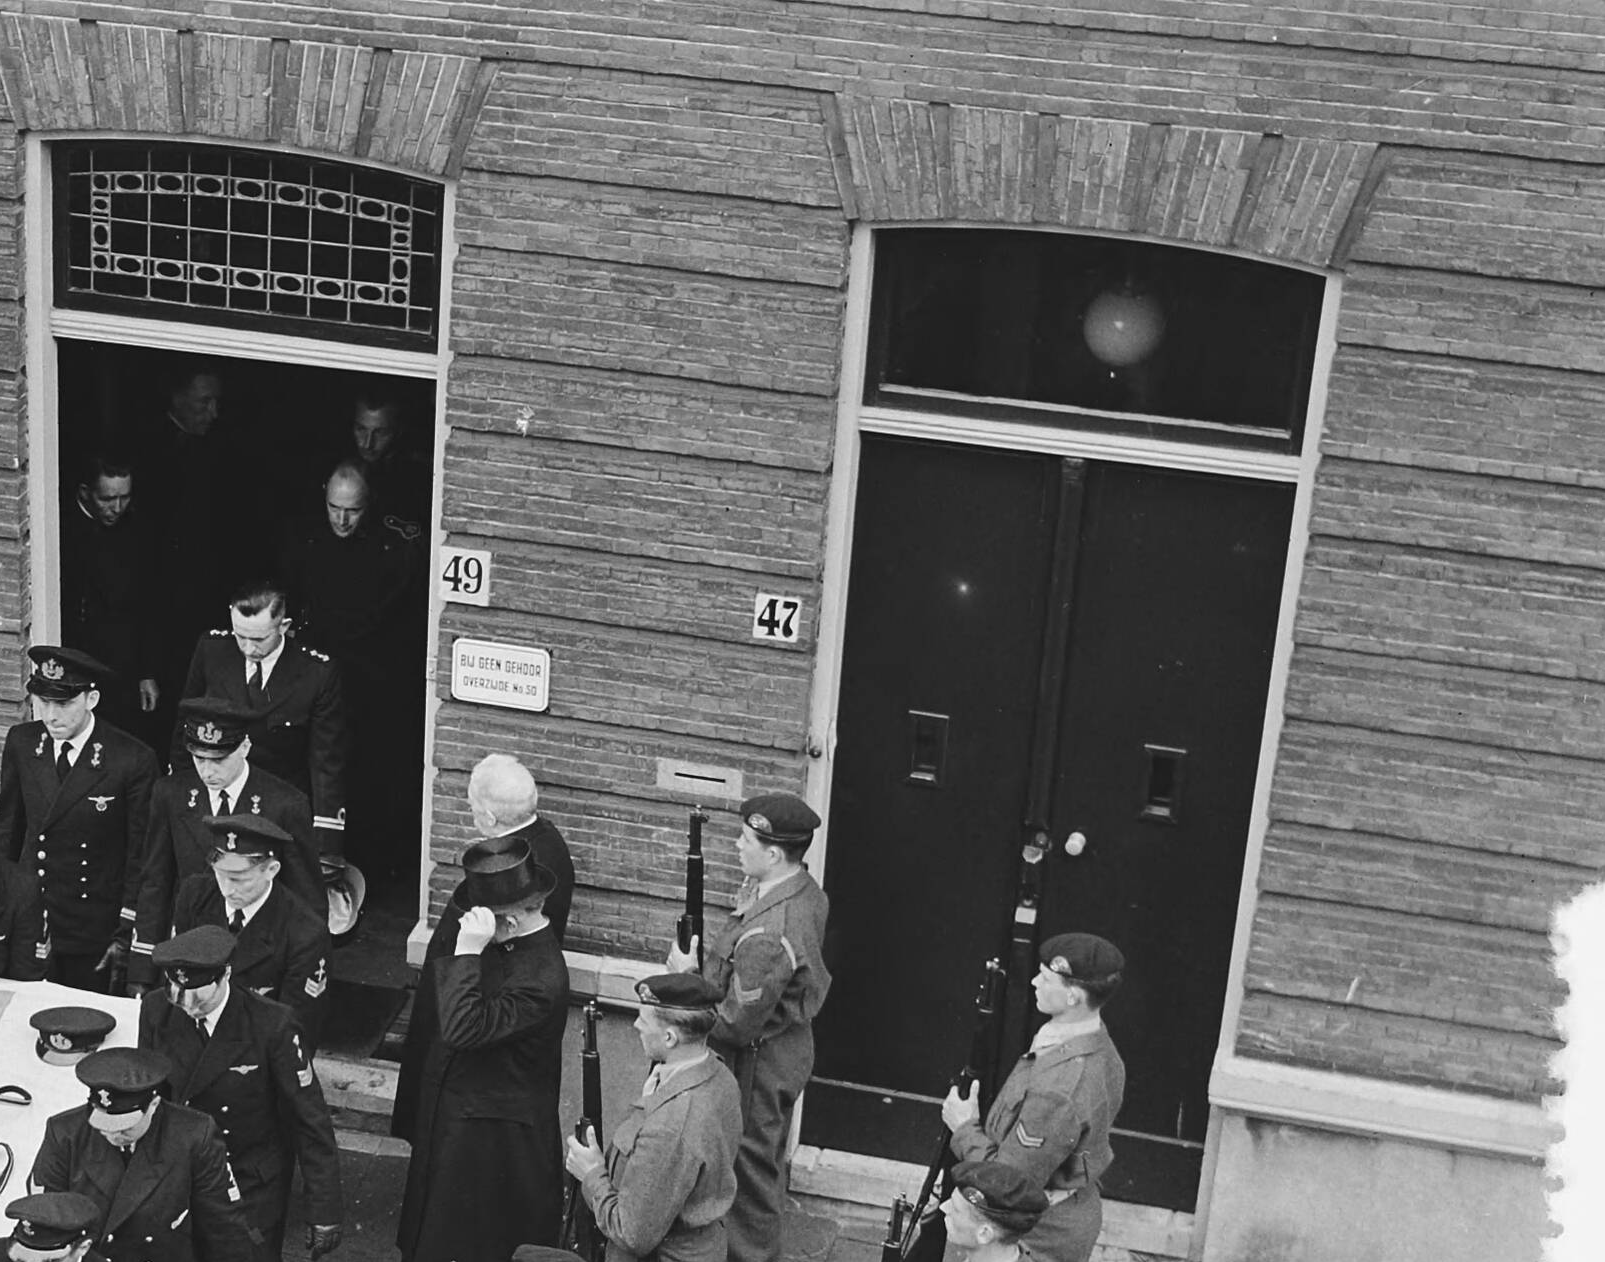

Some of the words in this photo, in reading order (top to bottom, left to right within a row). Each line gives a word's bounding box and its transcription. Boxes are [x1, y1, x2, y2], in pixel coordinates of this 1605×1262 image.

[442, 555, 483, 594] 49
[757, 598, 799, 638] 47
[460, 654, 475, 668] BIJ
[479, 656, 502, 671] GEEN
[505, 660, 542, 678] GEHOOR
[463, 675, 510, 692] OVERZIJDE
[526, 685, 537, 697] 50
